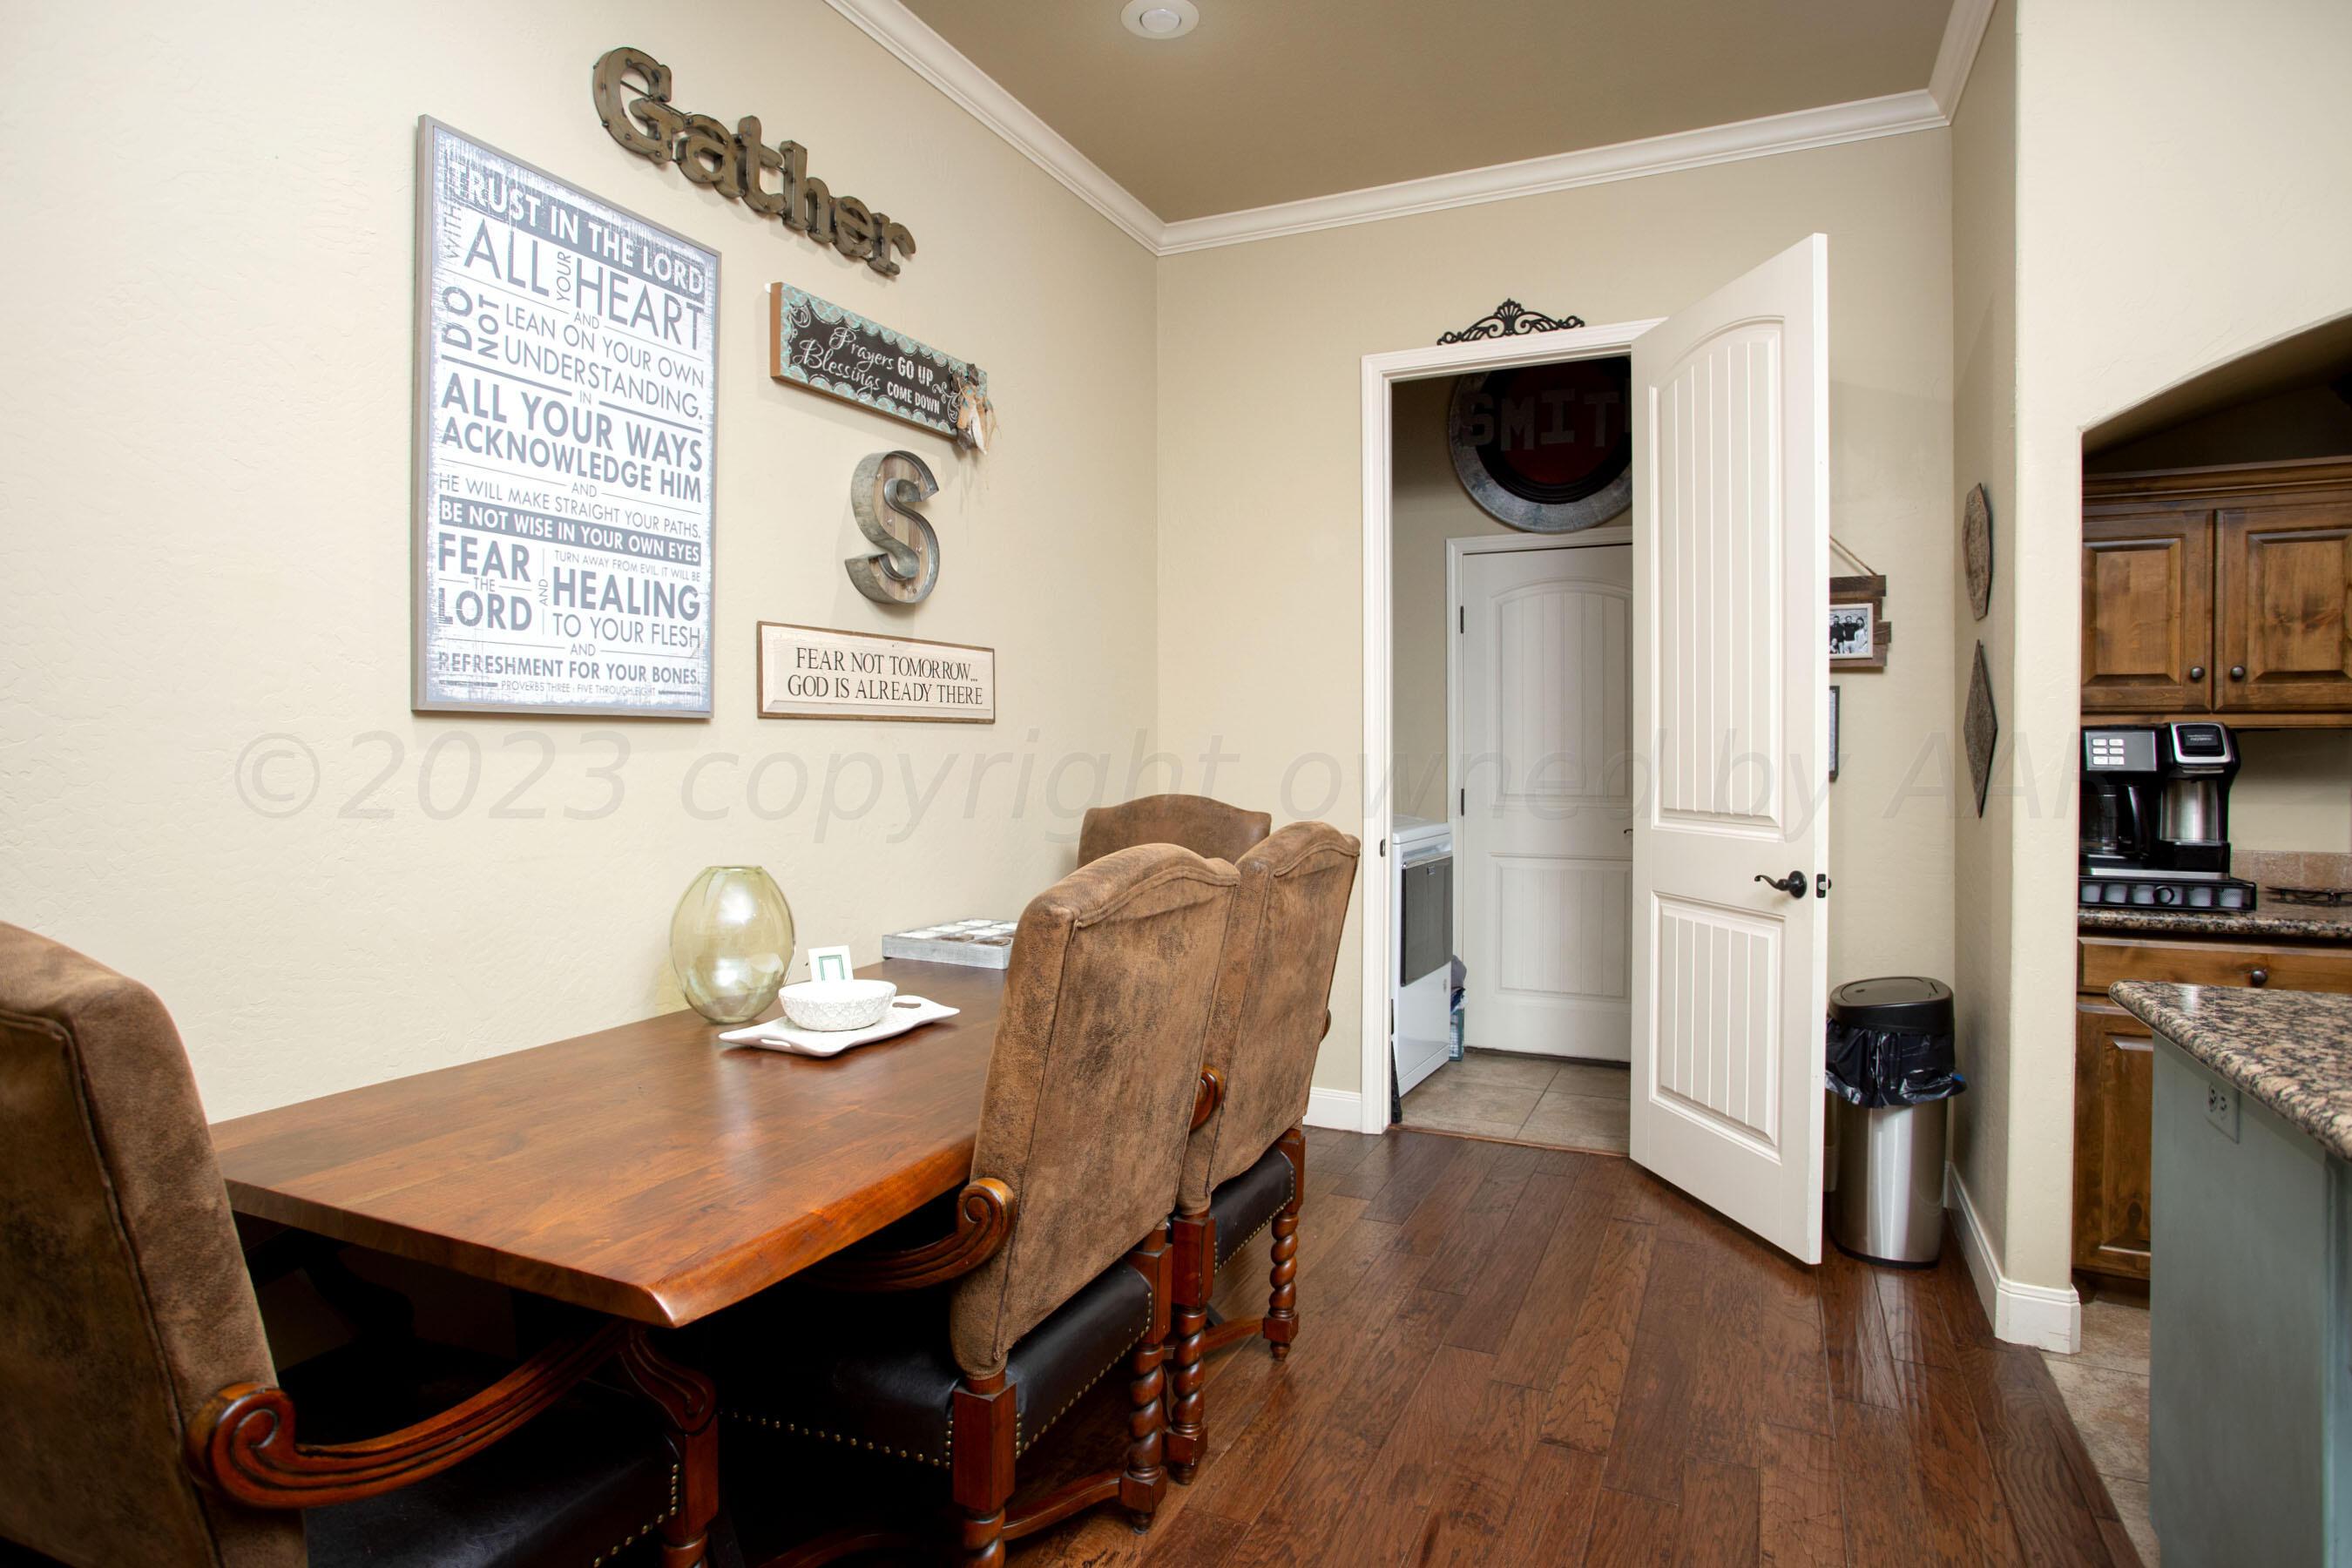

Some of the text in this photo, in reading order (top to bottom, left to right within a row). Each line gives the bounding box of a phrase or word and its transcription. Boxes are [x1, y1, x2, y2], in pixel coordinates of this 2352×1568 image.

[592, 47, 916, 276] Gather
[443, 205, 462, 259] WITH
[450, 160, 705, 296] TRUST IN THE LORD
[463, 218, 705, 350] ALL YOUR HEART
[441, 285, 473, 351] DO
[477, 294, 499, 360] NOT
[505, 303, 704, 389] LEAN ON YOUR OWN
[573, 311, 600, 330] AND
[504, 335, 703, 422] UNDERSTANDING.
[792, 338, 940, 415] Blessings COME DOWN
[828, 326, 934, 387] Prayers GO UP
[441, 372, 703, 473] ALL YOUR WAYS
[579, 389, 592, 405] IN
[1459, 378, 1632, 451] SMIT
[441, 416, 702, 504] ACKNOWLEDGE HIM
[439, 472, 701, 540] HE WILL MAKE STRAIGHT YOUR PATHS.
[571, 481, 598, 498] AND
[440, 500, 701, 564] BE NOT WISE IN YOUR OWN EYES
[844, 449, 940, 605] S
[437, 531, 531, 584] FEAR
[473, 577, 496, 593] THE
[554, 550, 580, 564] TURN
[583, 554, 609, 569] AWAY
[612, 558, 639, 573] FROM
[660, 566, 669, 578] IT
[670, 567, 690, 581] WILL
[691, 571, 701, 583] BE
[438, 586, 533, 632] LORD
[537, 578, 549, 607] AND
[551, 566, 701, 622] HEALING
[551, 612, 701, 649] TO YOUR FLESH
[569, 643, 597, 657] AND
[438, 651, 700, 686] REFRESHMENT FOR YOUR BONES.
[501, 680, 545, 693] PROVERBS
[547, 683, 571, 693] THREE
[576, 684, 594, 694] FIVE
[594, 684, 632, 696] THROUGH
[787, 673, 983, 706] GOD IS ALREADY THERE
[795, 646, 978, 683] FEAR NOT TOMORROW...
